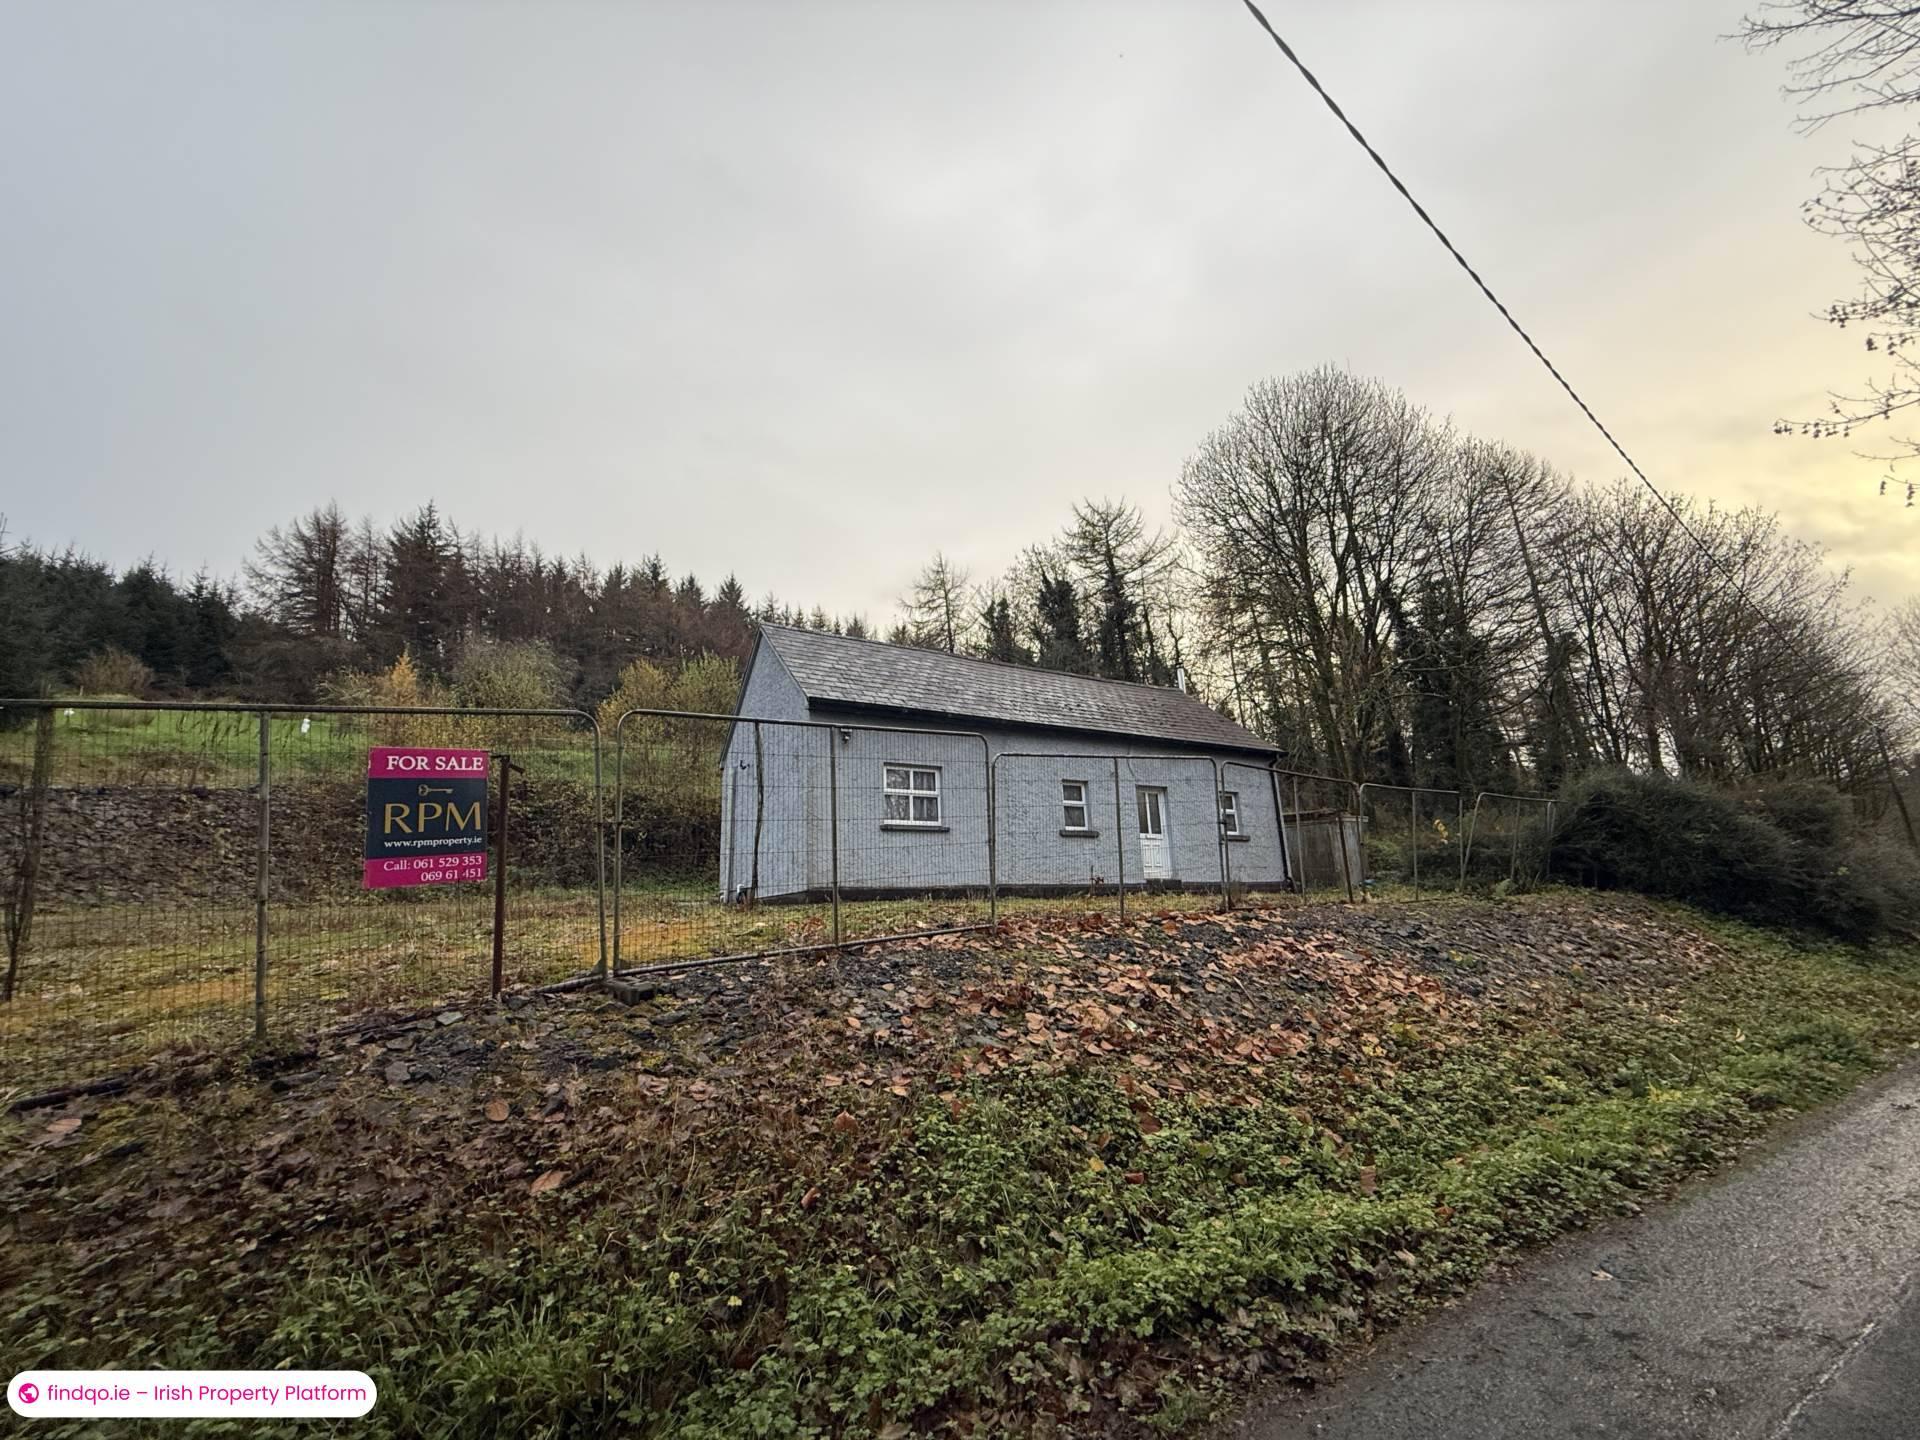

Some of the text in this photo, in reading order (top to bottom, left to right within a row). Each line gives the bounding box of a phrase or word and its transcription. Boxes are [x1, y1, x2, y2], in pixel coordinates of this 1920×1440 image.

[386, 755, 484, 771] FOR SALE
[384, 801, 481, 834] RPM
[384, 836, 482, 848] www.rpmproperty.ie
[383, 855, 482, 871] Call: 061 529 353
[421, 868, 482, 882] 069 61 451
